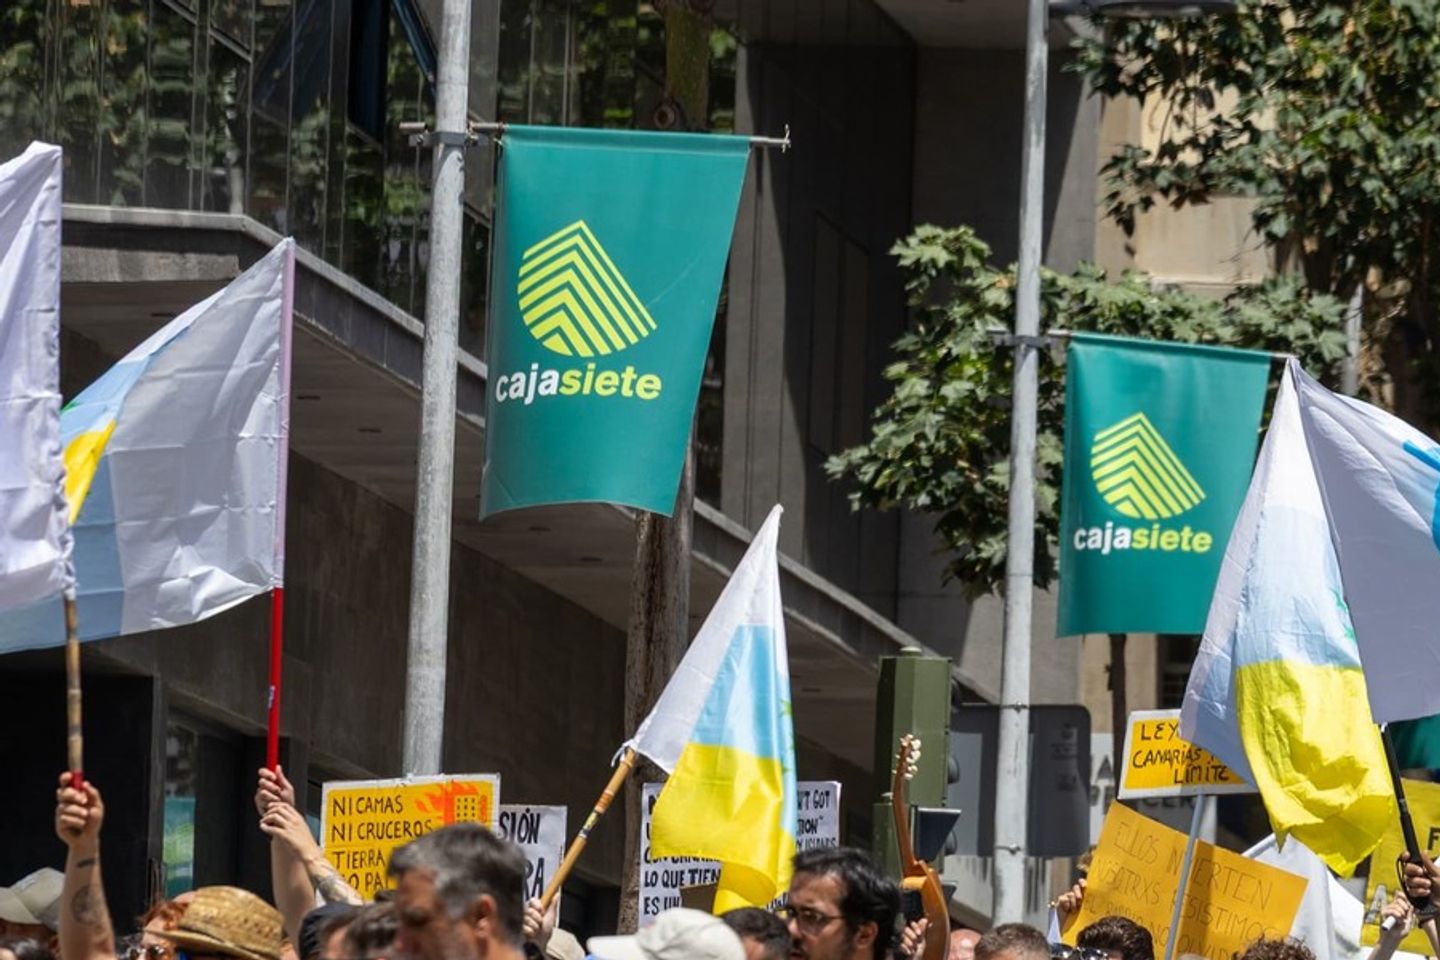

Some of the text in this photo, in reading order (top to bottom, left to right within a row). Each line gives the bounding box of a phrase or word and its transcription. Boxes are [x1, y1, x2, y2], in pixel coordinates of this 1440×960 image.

[495, 362, 662, 405] cajasiete
[1073, 521, 1213, 555] cajasiete
[332, 794, 404, 816] NI CAMAS
[331, 818, 433, 842] NI CRUCEROS
[333, 847, 386, 871] TIERRA
[644, 869, 659, 889] LO
[661, 868, 685, 888] QUE
[643, 896, 660, 916] ES
